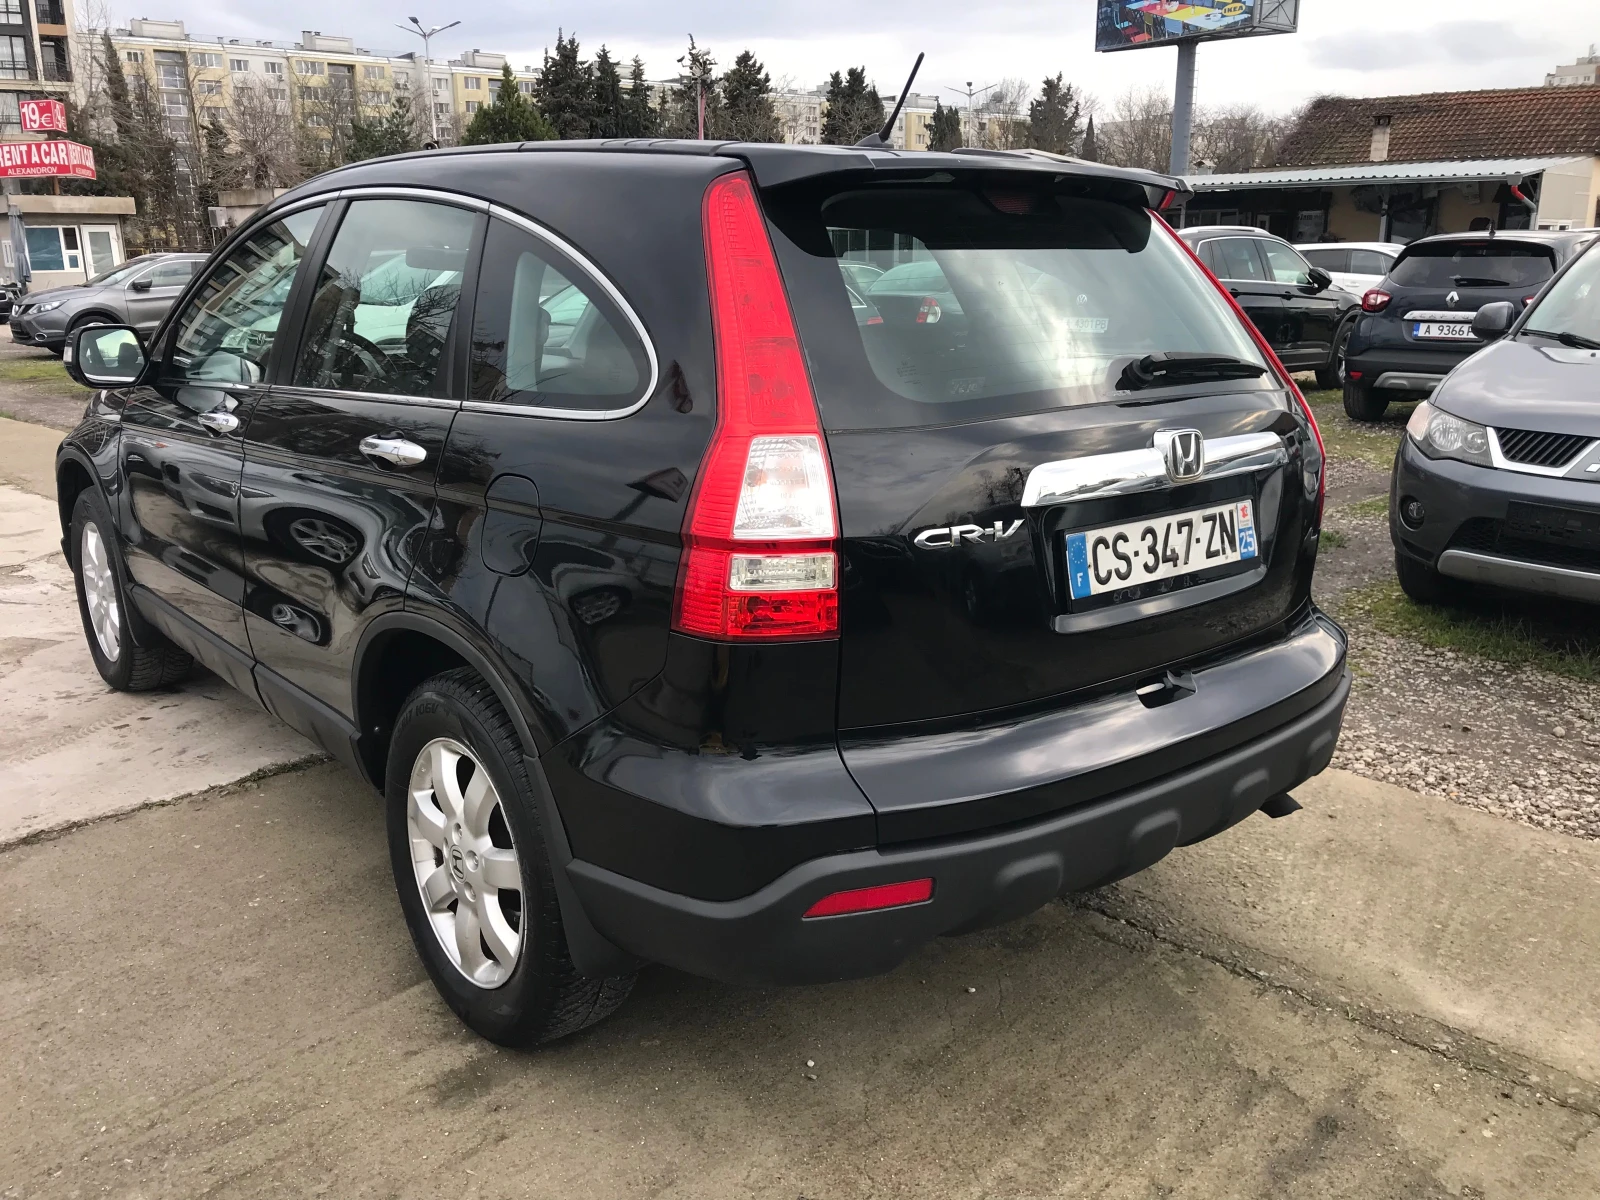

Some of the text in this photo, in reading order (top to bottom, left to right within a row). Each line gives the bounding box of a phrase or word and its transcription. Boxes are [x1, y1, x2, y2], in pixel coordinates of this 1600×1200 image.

[1223, 5, 1244, 14] IKEA
[31, 144, 40, 164] A
[40, 143, 69, 166] CAR
[7, 166, 58, 175] ALEXANDROV
[1423, 325, 1431, 336] A
[1437, 325, 1465, 336] 9366
[913, 518, 1026, 550] CR-V
[1239, 530, 1255, 553] 25
[1077, 572, 1083, 587] F
